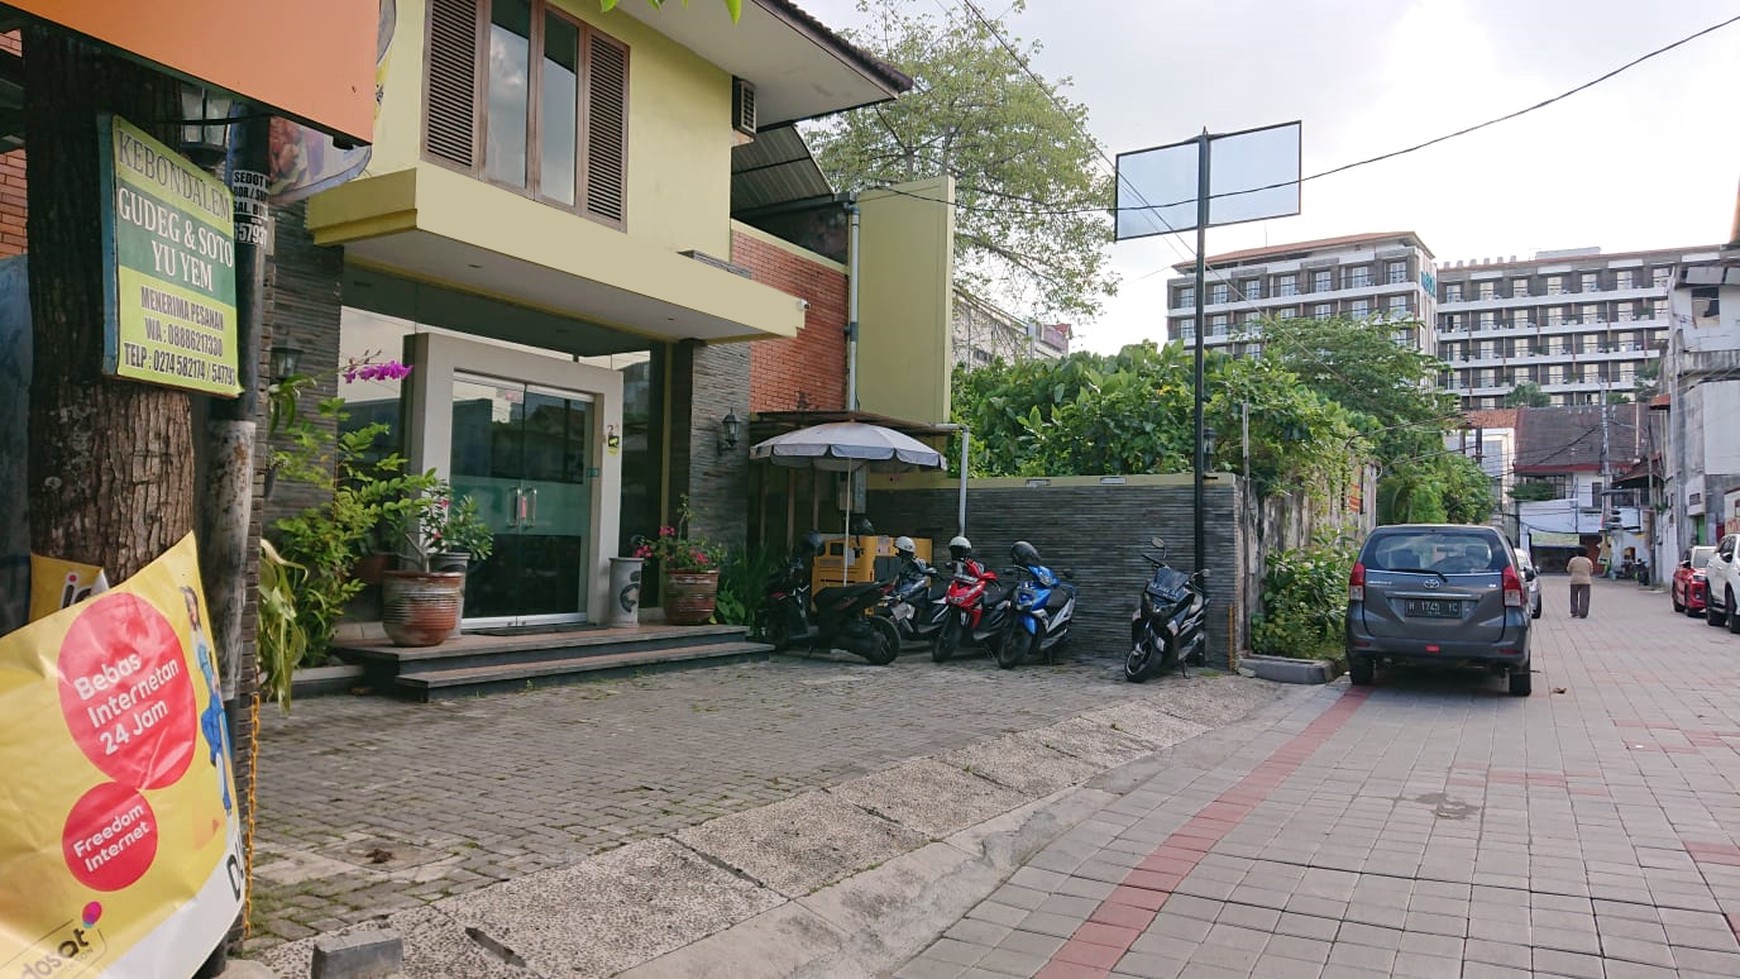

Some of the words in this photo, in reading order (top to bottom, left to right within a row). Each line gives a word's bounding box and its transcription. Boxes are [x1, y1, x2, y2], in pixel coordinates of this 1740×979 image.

[118, 130, 231, 224] KEBONDALEM
[234, 171, 263, 187] SEDOT
[118, 188, 180, 243] GUDEG
[184, 220, 197, 250] &
[199, 227, 233, 268] SOTO
[151, 239, 176, 277] YU
[180, 251, 213, 292] YEM
[141, 286, 190, 321] MENERIMA
[190, 302, 224, 331] PESANAN
[153, 350, 175, 374] 0274
[73, 653, 142, 701] Bebas
[87, 658, 180, 728] Internetan
[99, 723, 130, 756] 24
[133, 700, 169, 736] Jam
[73, 805, 145, 858] Freedom
[84, 821, 150, 873] Internet
